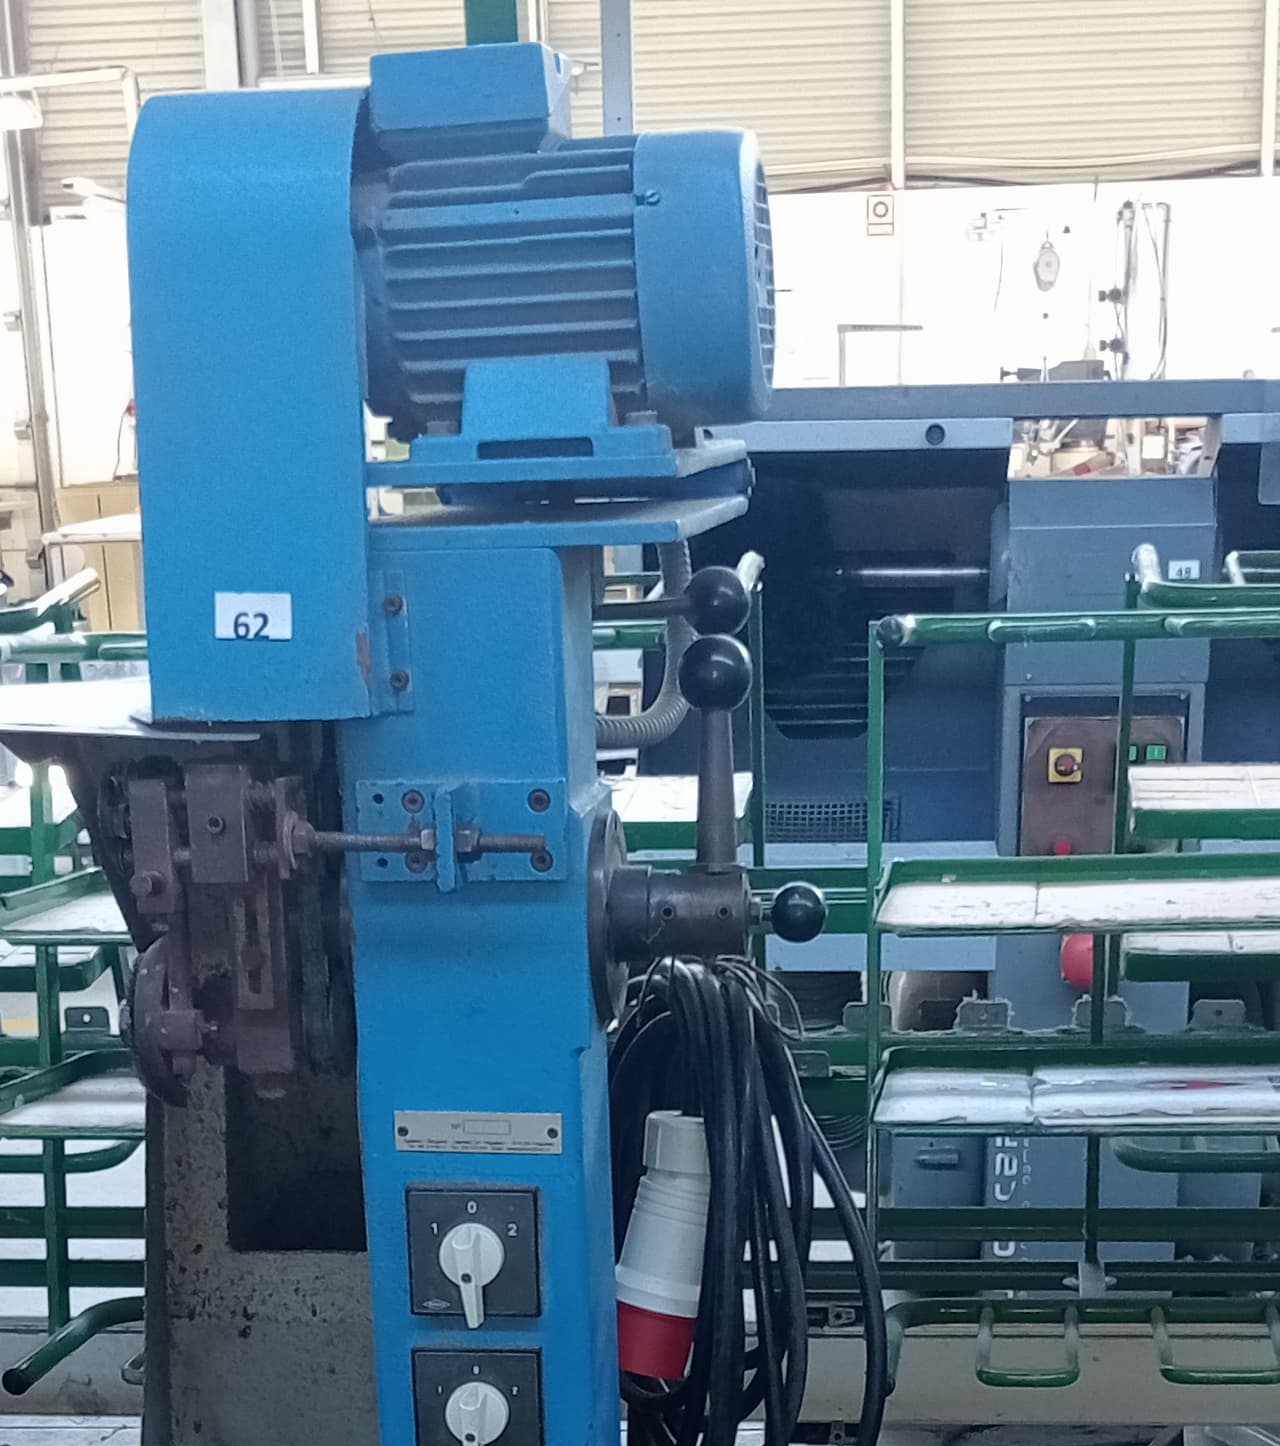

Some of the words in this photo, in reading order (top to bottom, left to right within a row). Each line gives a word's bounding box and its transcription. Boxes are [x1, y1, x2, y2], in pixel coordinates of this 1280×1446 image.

[233, 612, 270, 640] 62
[467, 1201, 477, 1213] 0
[431, 1222, 439, 1235] 1
[507, 1223, 518, 1236] 2
